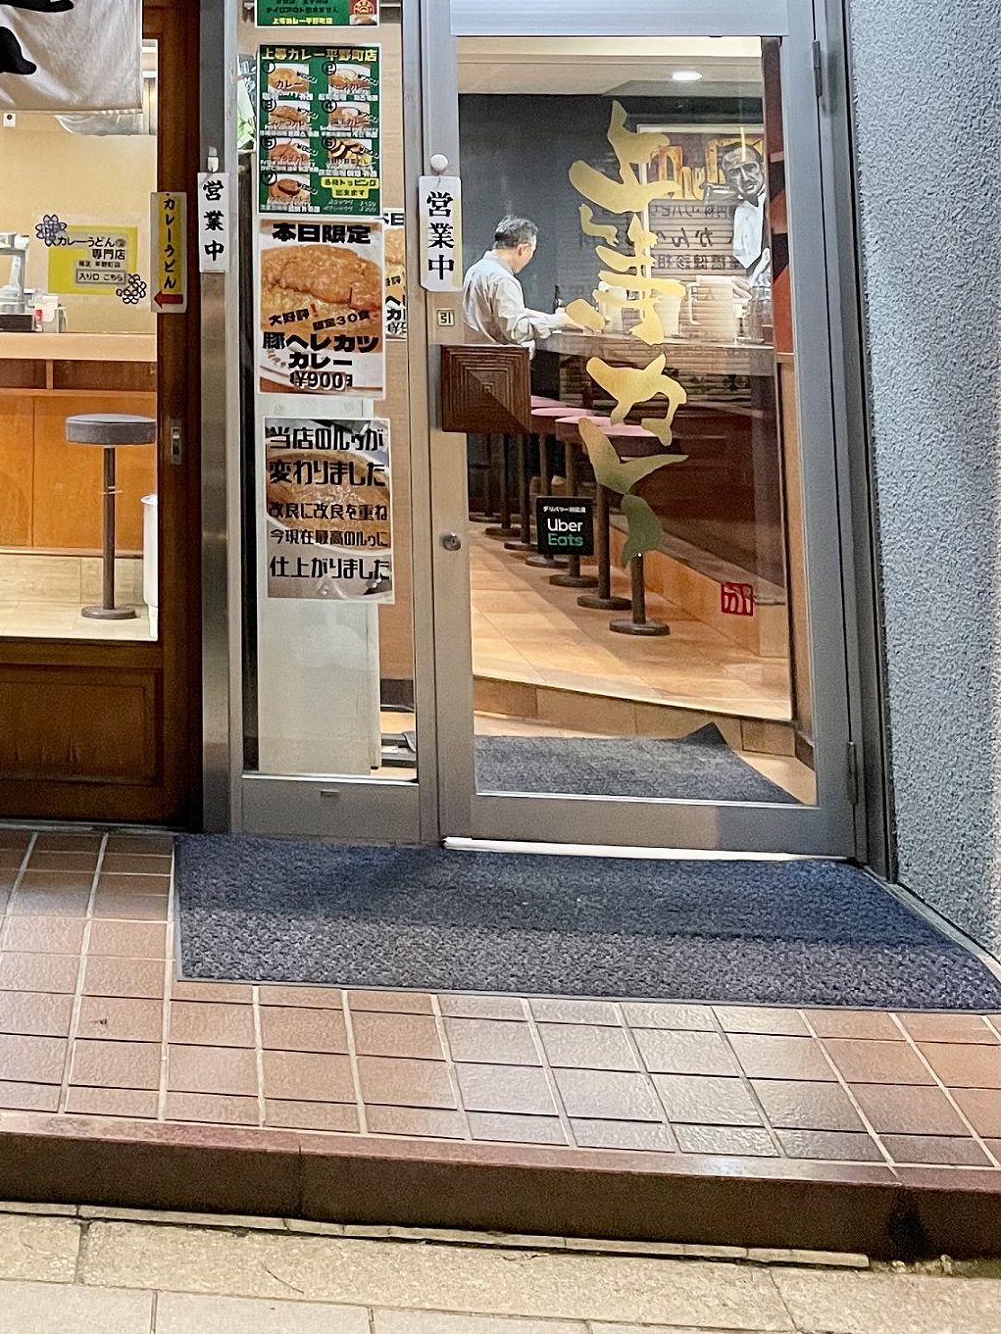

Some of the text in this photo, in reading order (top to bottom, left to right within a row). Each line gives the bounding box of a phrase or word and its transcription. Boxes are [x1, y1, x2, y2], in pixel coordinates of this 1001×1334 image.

[261, 48, 378, 62] 上等カレー平野町店
[202, 180, 225, 262] 営業中
[272, 223, 371, 244] 本日限定
[426, 191, 455, 281] 営業中
[163, 198, 177, 290] カレーうどん
[92, 249, 126, 260] 専門店
[103, 273, 123, 281] こちら
[262, 331, 379, 353] 豚ヘレカツ
[289, 352, 353, 369] カレー
[269, 426, 384, 451] 当店のルゥが
[269, 460, 386, 486] 変わりました
[269, 502, 388, 521] 改良に改良を重ね
[547, 518, 583, 532] Uber
[270, 529, 388, 547] 今現在最高のルゥに
[548, 532, 584, 546] Eats
[269, 555, 390, 580] 仕上がりました
